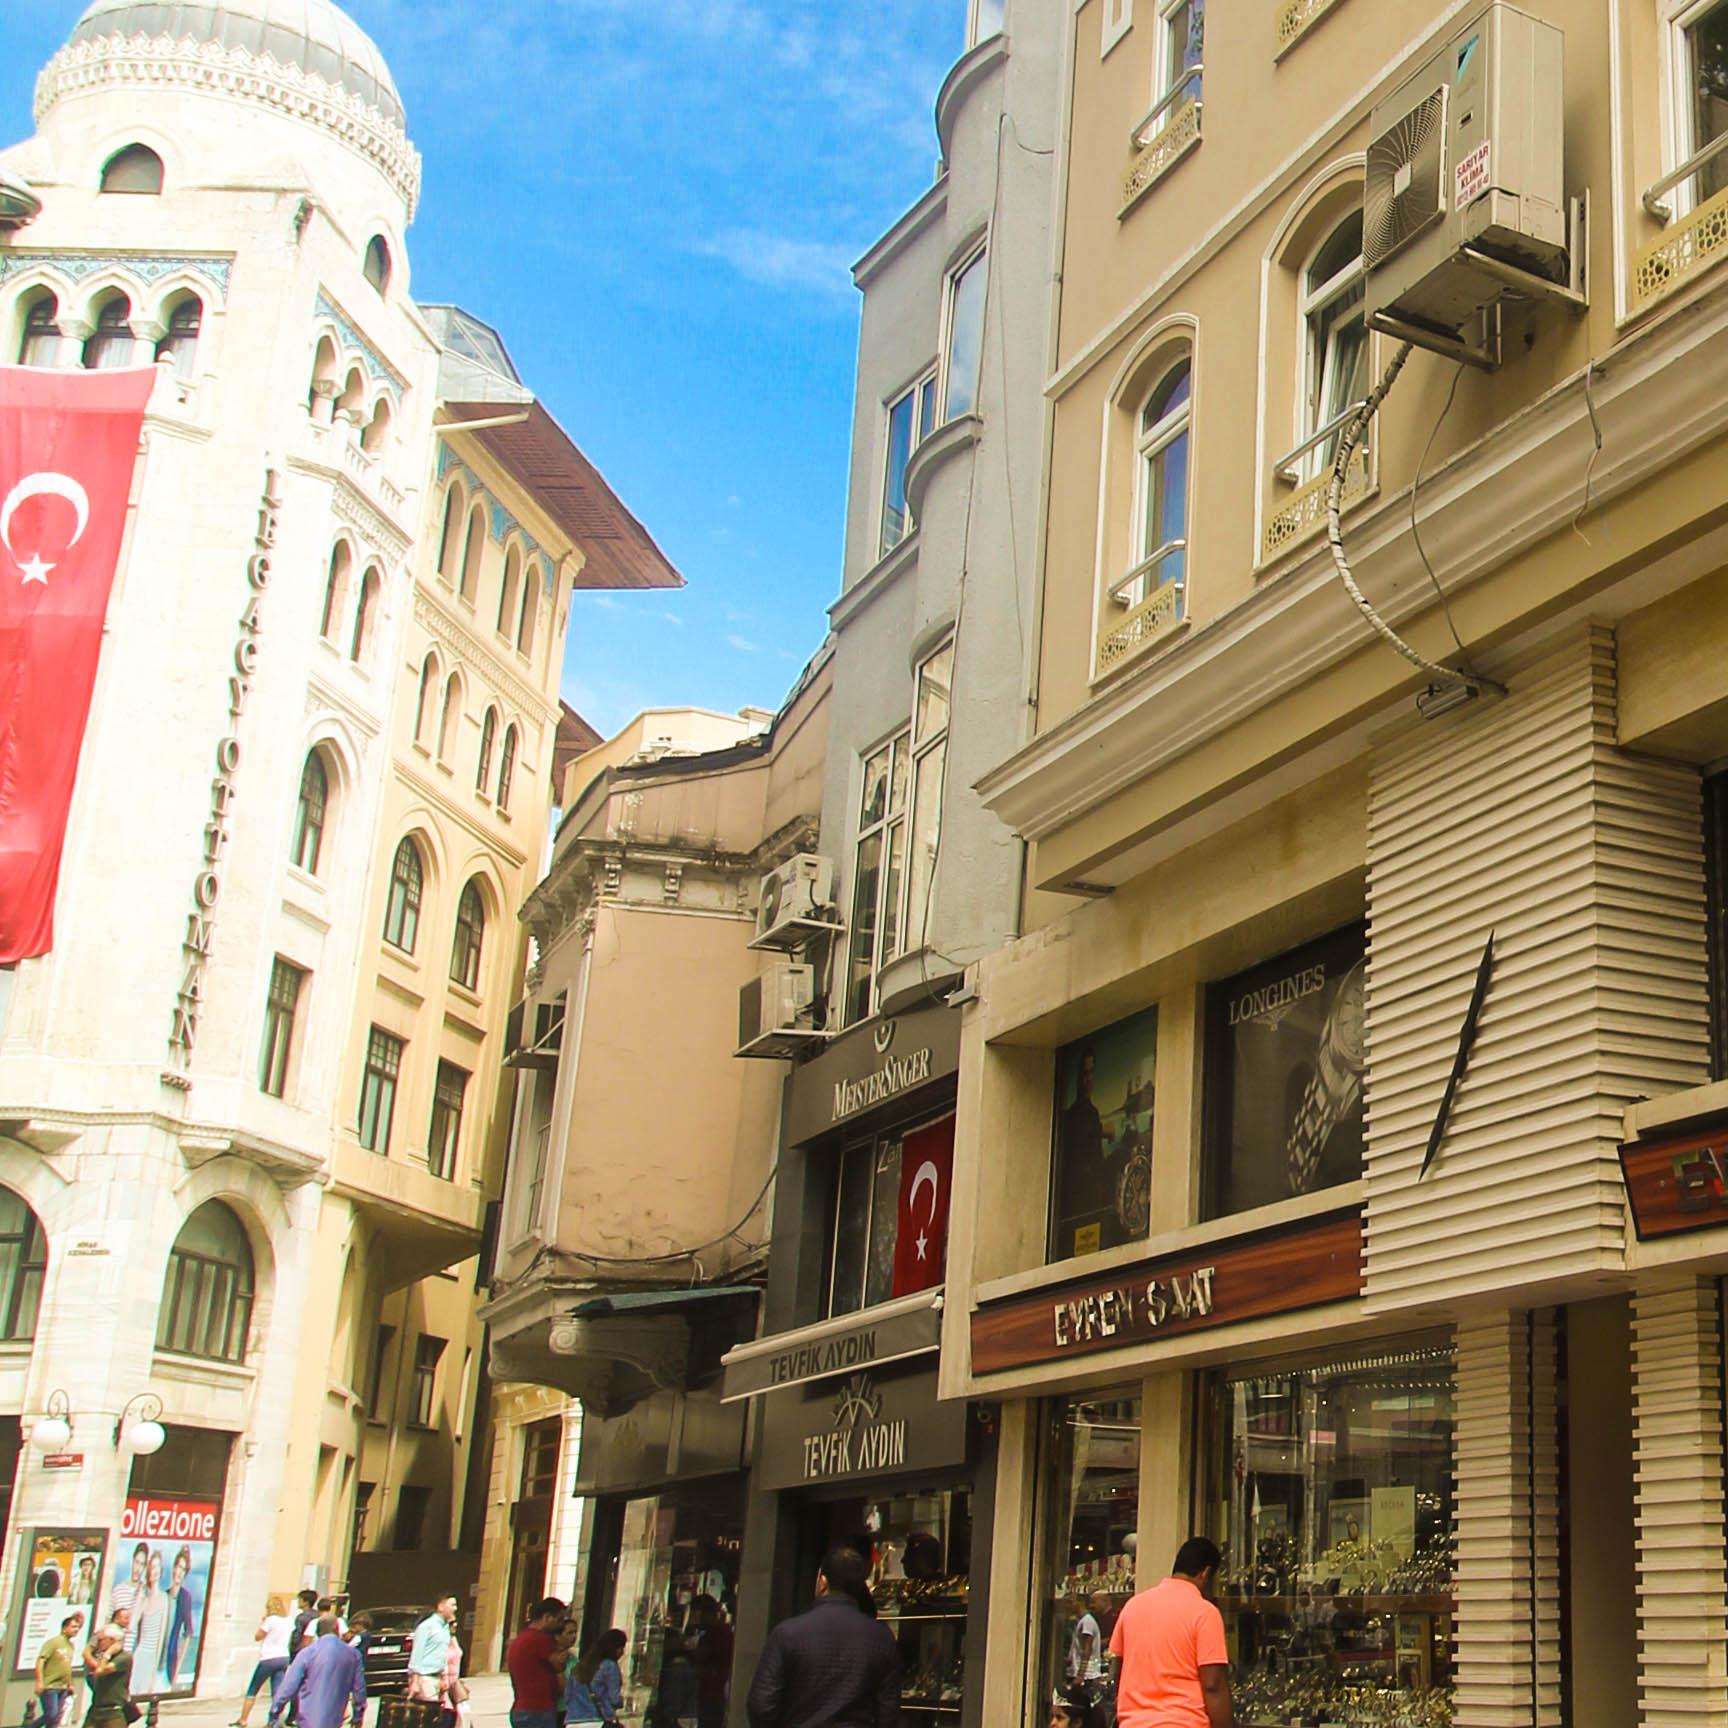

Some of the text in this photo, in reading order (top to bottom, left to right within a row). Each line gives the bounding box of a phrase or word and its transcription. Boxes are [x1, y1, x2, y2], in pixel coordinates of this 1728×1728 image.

[229, 468, 283, 717] LEGACY
[168, 736, 243, 1051] OTTOMAN
[1228, 963, 1327, 1026] LONGINES
[1053, 1266, 1216, 1348] EVREN SAAT
[822, 1328, 877, 1371] AYDIN
[857, 1418, 906, 1471] AYDIN
